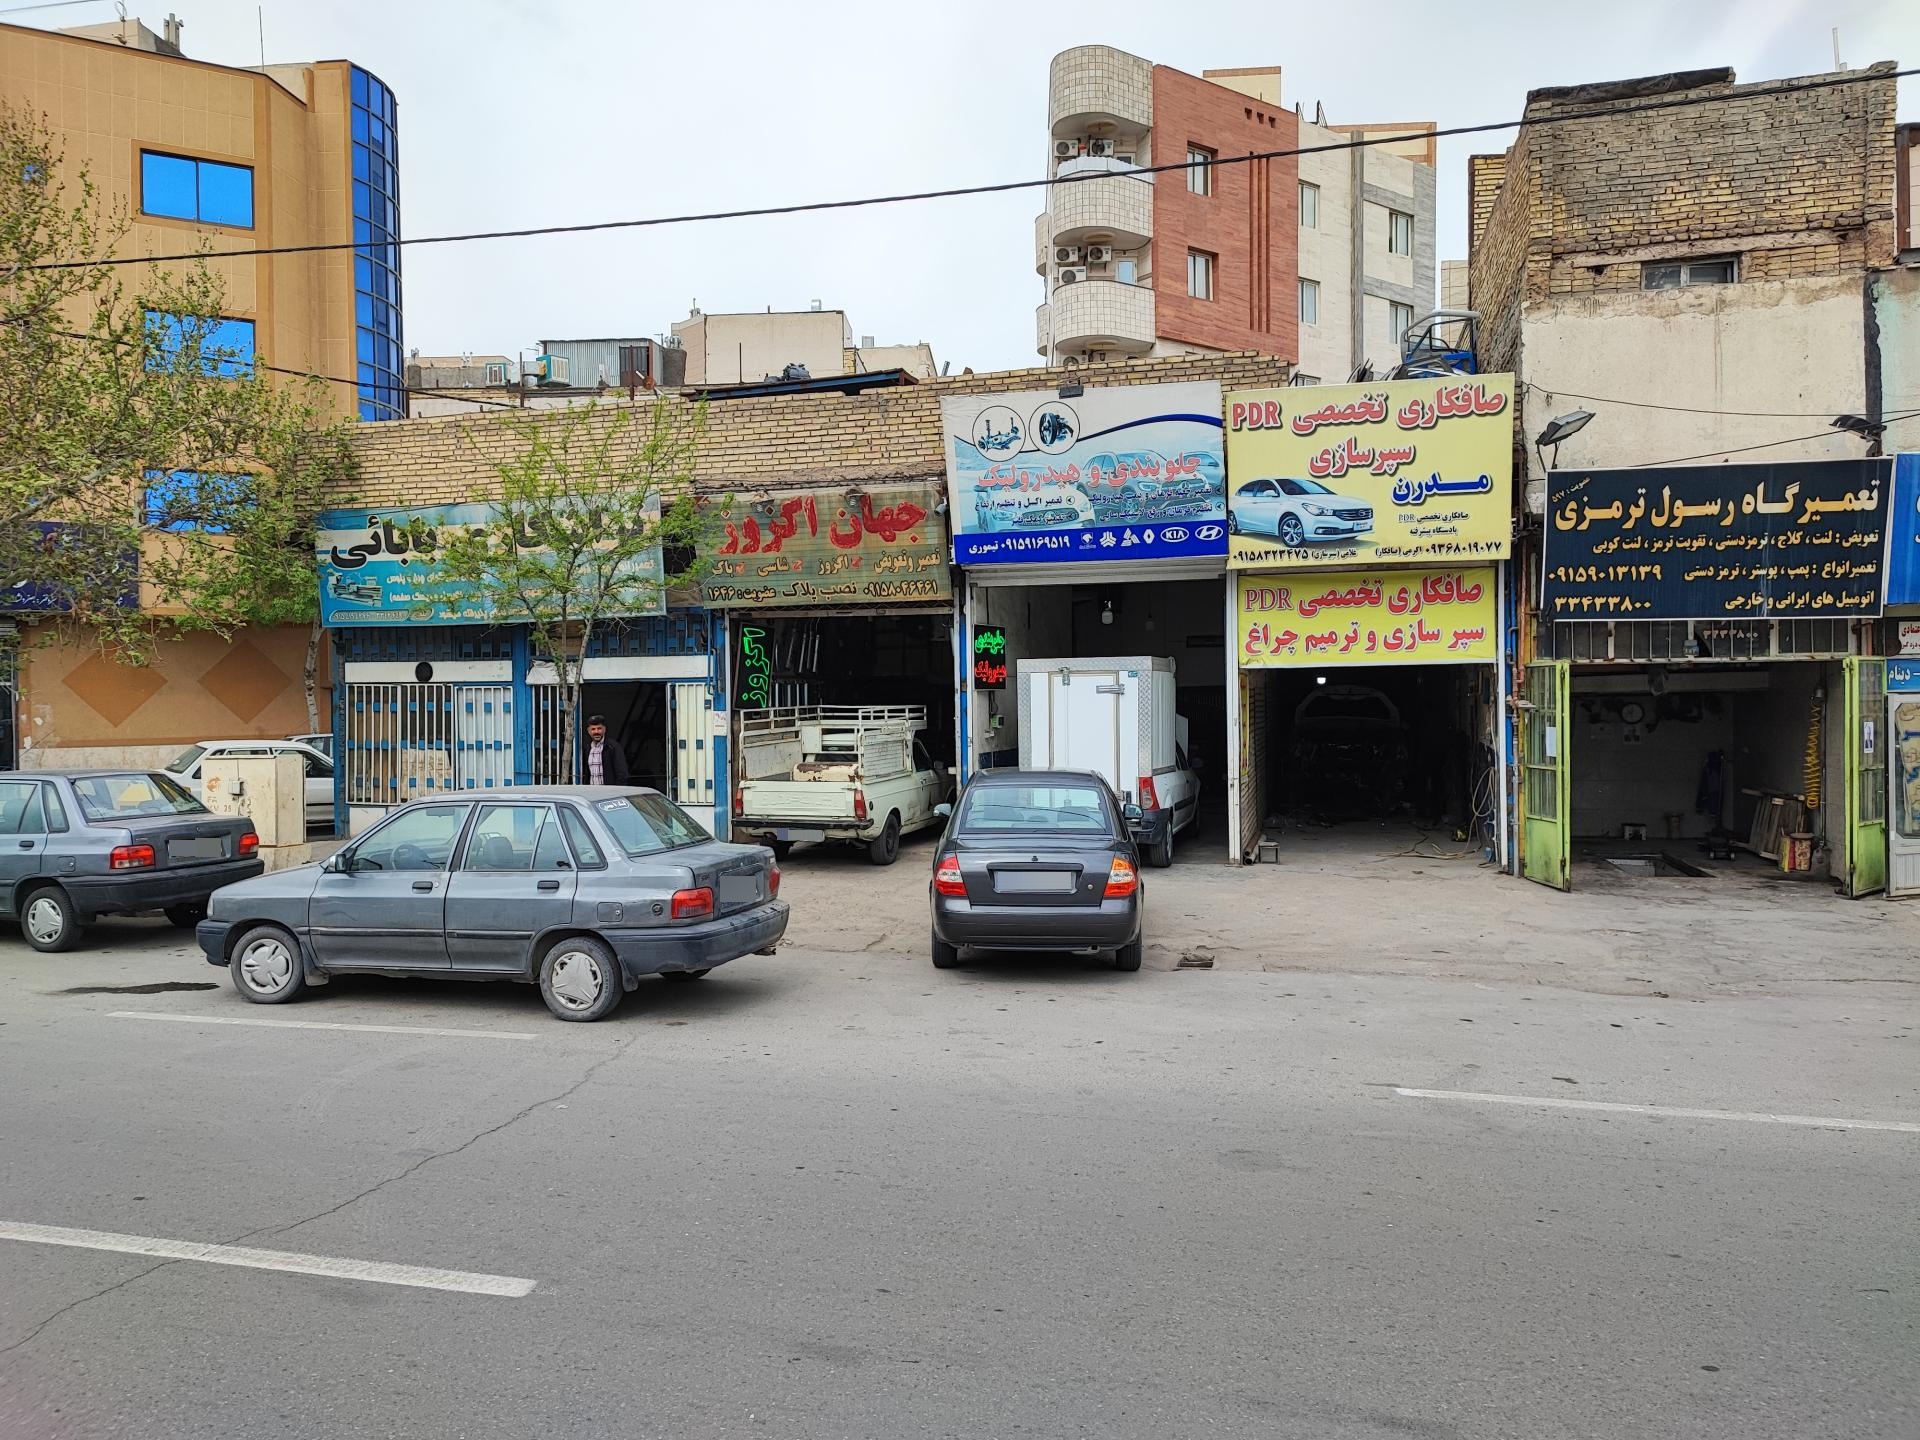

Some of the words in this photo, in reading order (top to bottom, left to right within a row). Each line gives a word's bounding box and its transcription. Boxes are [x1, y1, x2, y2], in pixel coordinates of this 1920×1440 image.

[1231, 400, 1281, 428] PDR
[1292, 393, 1385, 432] تخصصی
[1397, 384, 1504, 427] صافکاری
[977, 463, 1081, 493] هیدرولیک
[1086, 465, 1101, 488] و
[1150, 488, 1173, 501] فرمان
[1392, 472, 1490, 502] مدرن
[974, 500, 995, 512] ارتفاع
[996, 499, 1016, 509] تنظیم
[1045, 496, 1063, 508] تعمیر
[1168, 506, 1191, 517] فرمان
[1191, 503, 1213, 514] تنظیم
[1555, 487, 1647, 531] ترمزی
[1650, 484, 1736, 528] رسول
[1741, 480, 1881, 524] تعمیرگاه
[829, 494, 929, 550] جهان
[1001, 535, 1071, 551] ۰۹۱۵۹۱۶۹۵۱۹
[1165, 530, 1185, 540] KIA
[1621, 535, 1642, 550] لنت
[1675, 533, 1708, 552] تقویت
[969, 540, 999, 555] تیموری
[1425, 541, 1502, 555] ۰۹۳۶۸۰۱۹۰۷۷
[1592, 536, 1622, 554] کوبی
[916, 548, 941, 573] تعمیر
[1232, 548, 1309, 562] ۰۹۱۵۸۳۲۳۴۷۵
[712, 560, 734, 578] باک
[756, 556, 790, 577] شاسی
[1547, 564, 1663, 583] ۰۹۱۵۹۰۱۳۱۳۹
[1683, 565, 1714, 582] دستی
[707, 585, 736, 601] ۱۶۴۶
[781, 580, 817, 603] پلاک
[818, 581, 858, 601] نصب
[862, 579, 939, 598] ۰۹۱۵۸۰۴۶۴۶۱
[1298, 578, 1383, 617] تخصصی
[1387, 573, 1483, 614] صافکاری
[1244, 586, 1293, 611] PDR
[1554, 595, 1652, 613] ۳۳۴۳۳۸۰۰
[1724, 591, 1765, 610] خارجی
[1765, 595, 1774, 610] و
[1775, 591, 1810, 610] ایرانی
[1811, 590, 1834, 610] های
[1835, 589, 1875, 609] اتومبیل
[1244, 621, 1299, 655] چراغ
[1303, 620, 1359, 653] ترمیم
[1364, 629, 1378, 652] و
[1888, 664, 1911, 685] دینام
